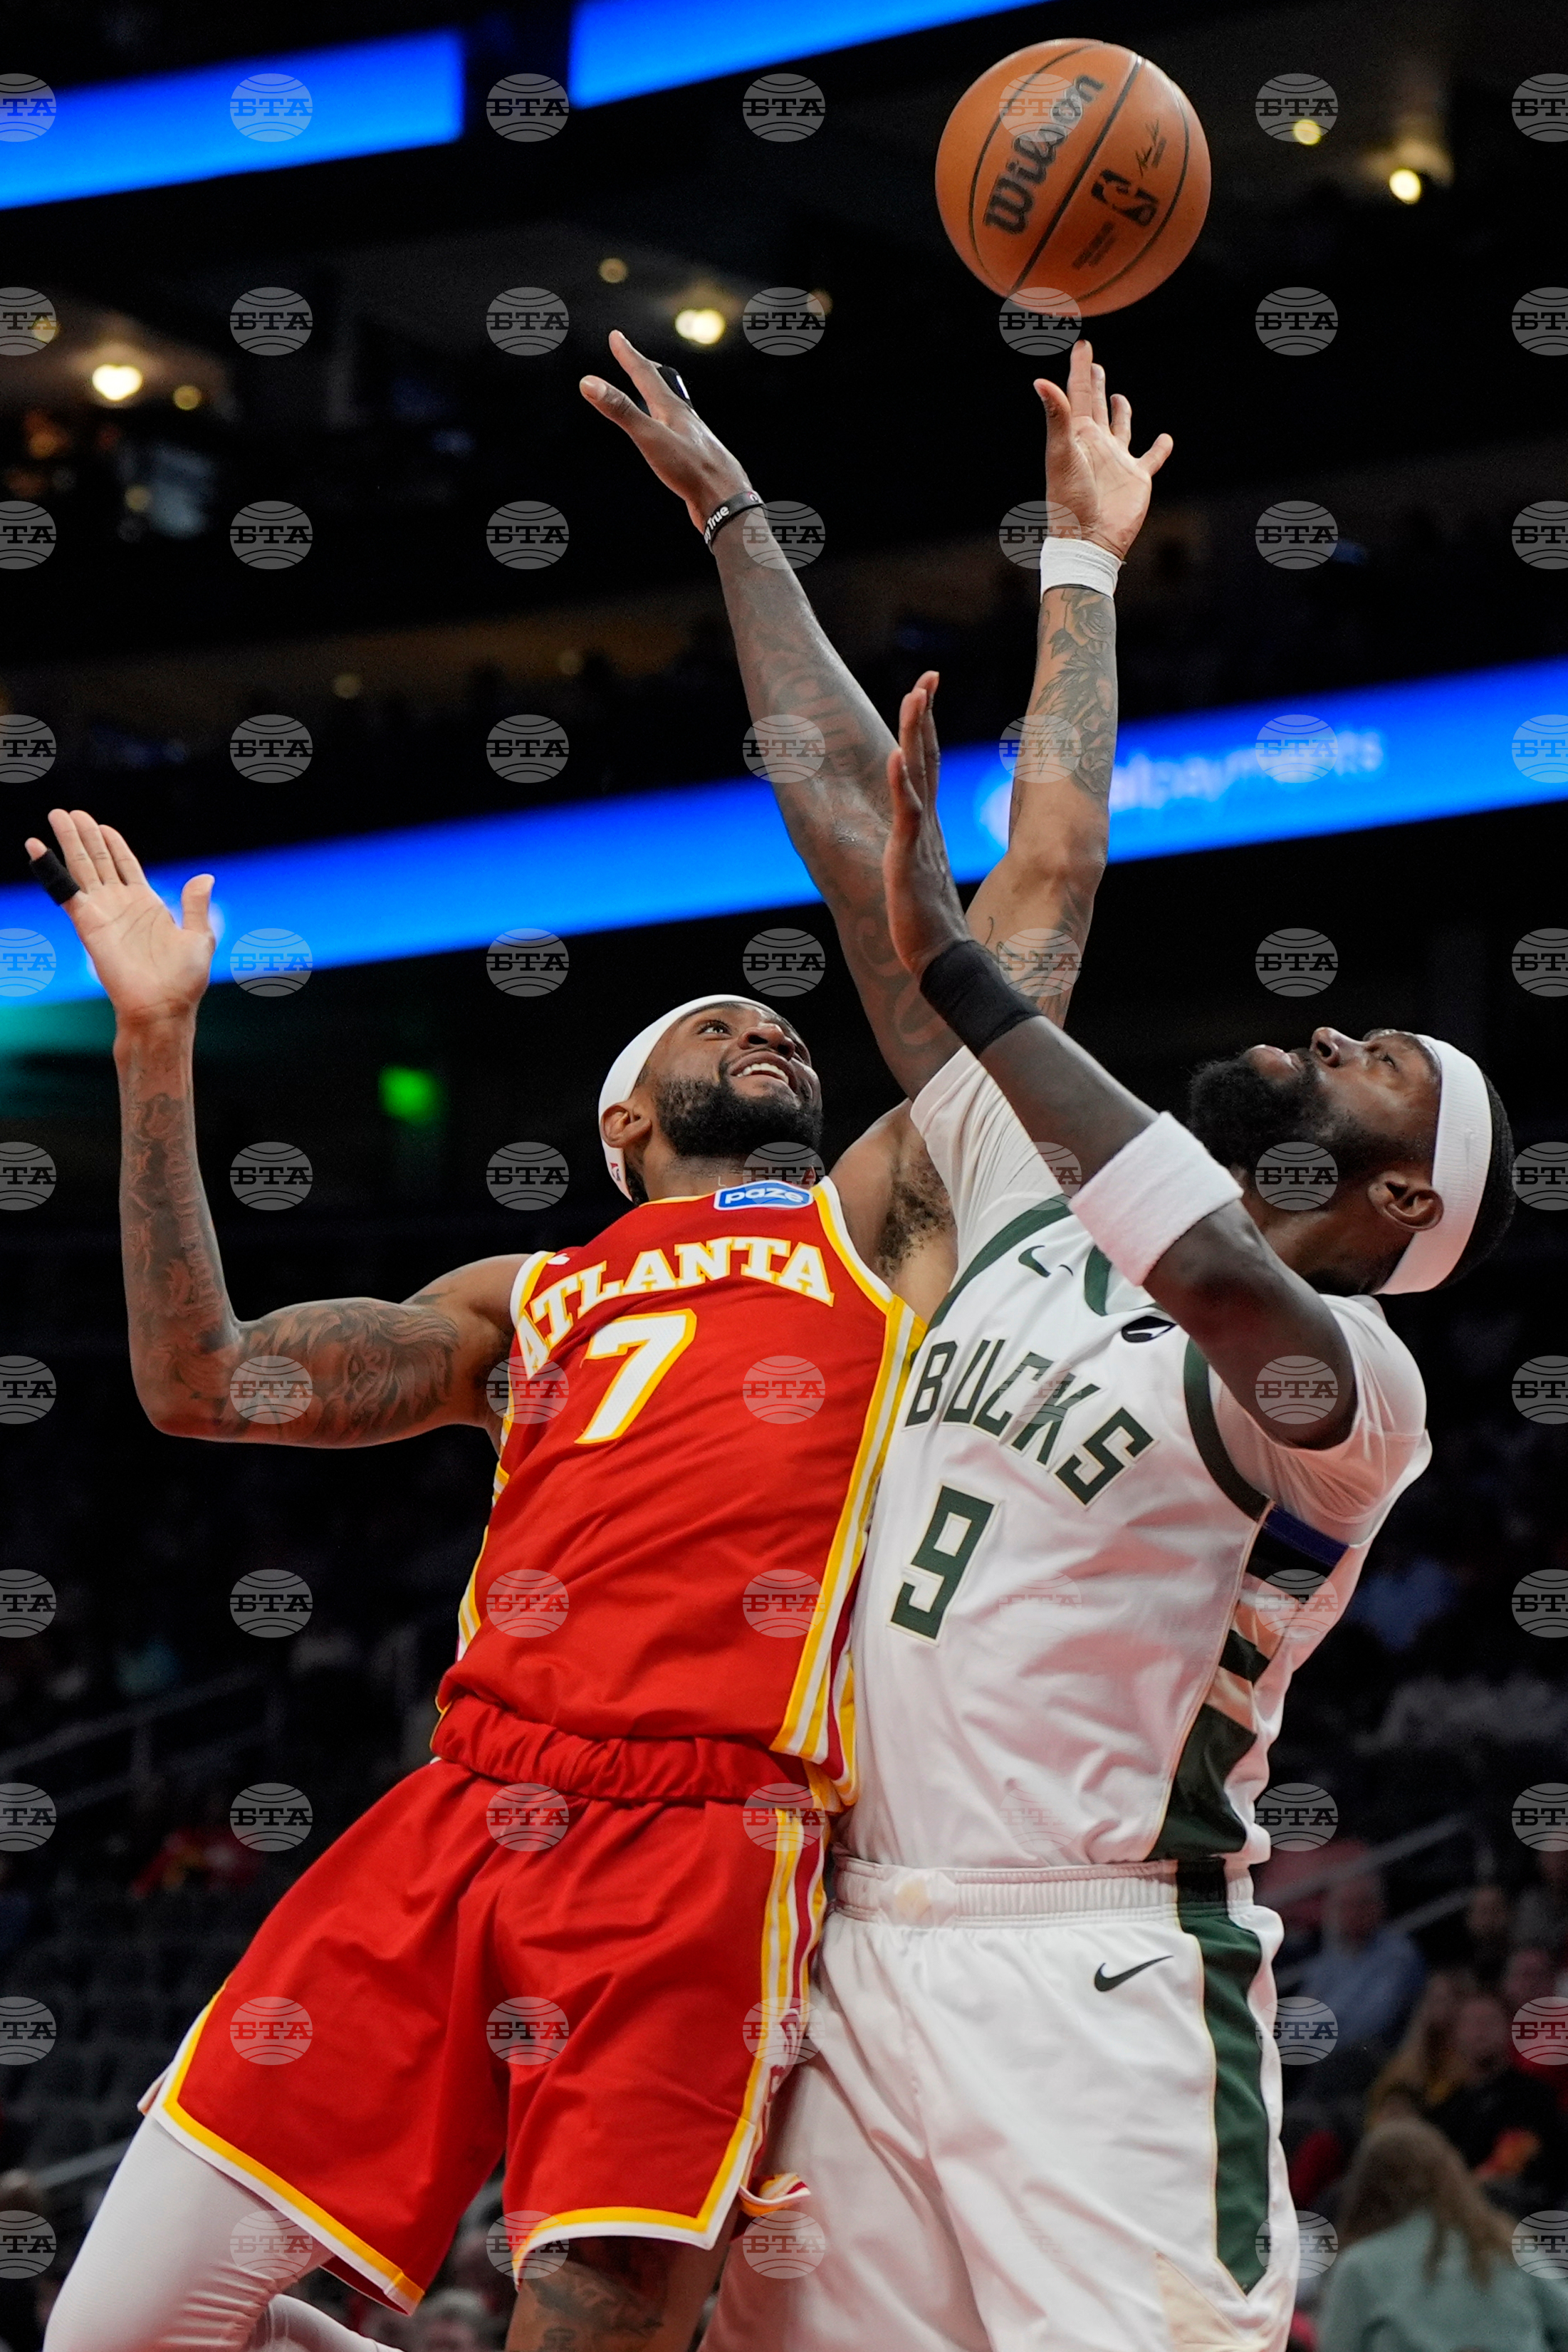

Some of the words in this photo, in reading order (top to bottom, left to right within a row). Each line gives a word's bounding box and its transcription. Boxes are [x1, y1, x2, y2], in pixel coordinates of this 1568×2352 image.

[983, 75, 1105, 235] Wilson
[707, 506, 730, 530] True
[724, 1187, 804, 1204] paze
[516, 1237, 835, 1380] ATLANTA
[574, 1308, 697, 1445] 7
[903, 1339, 1158, 1509] BUCKS
[889, 1481, 998, 1644] 9
